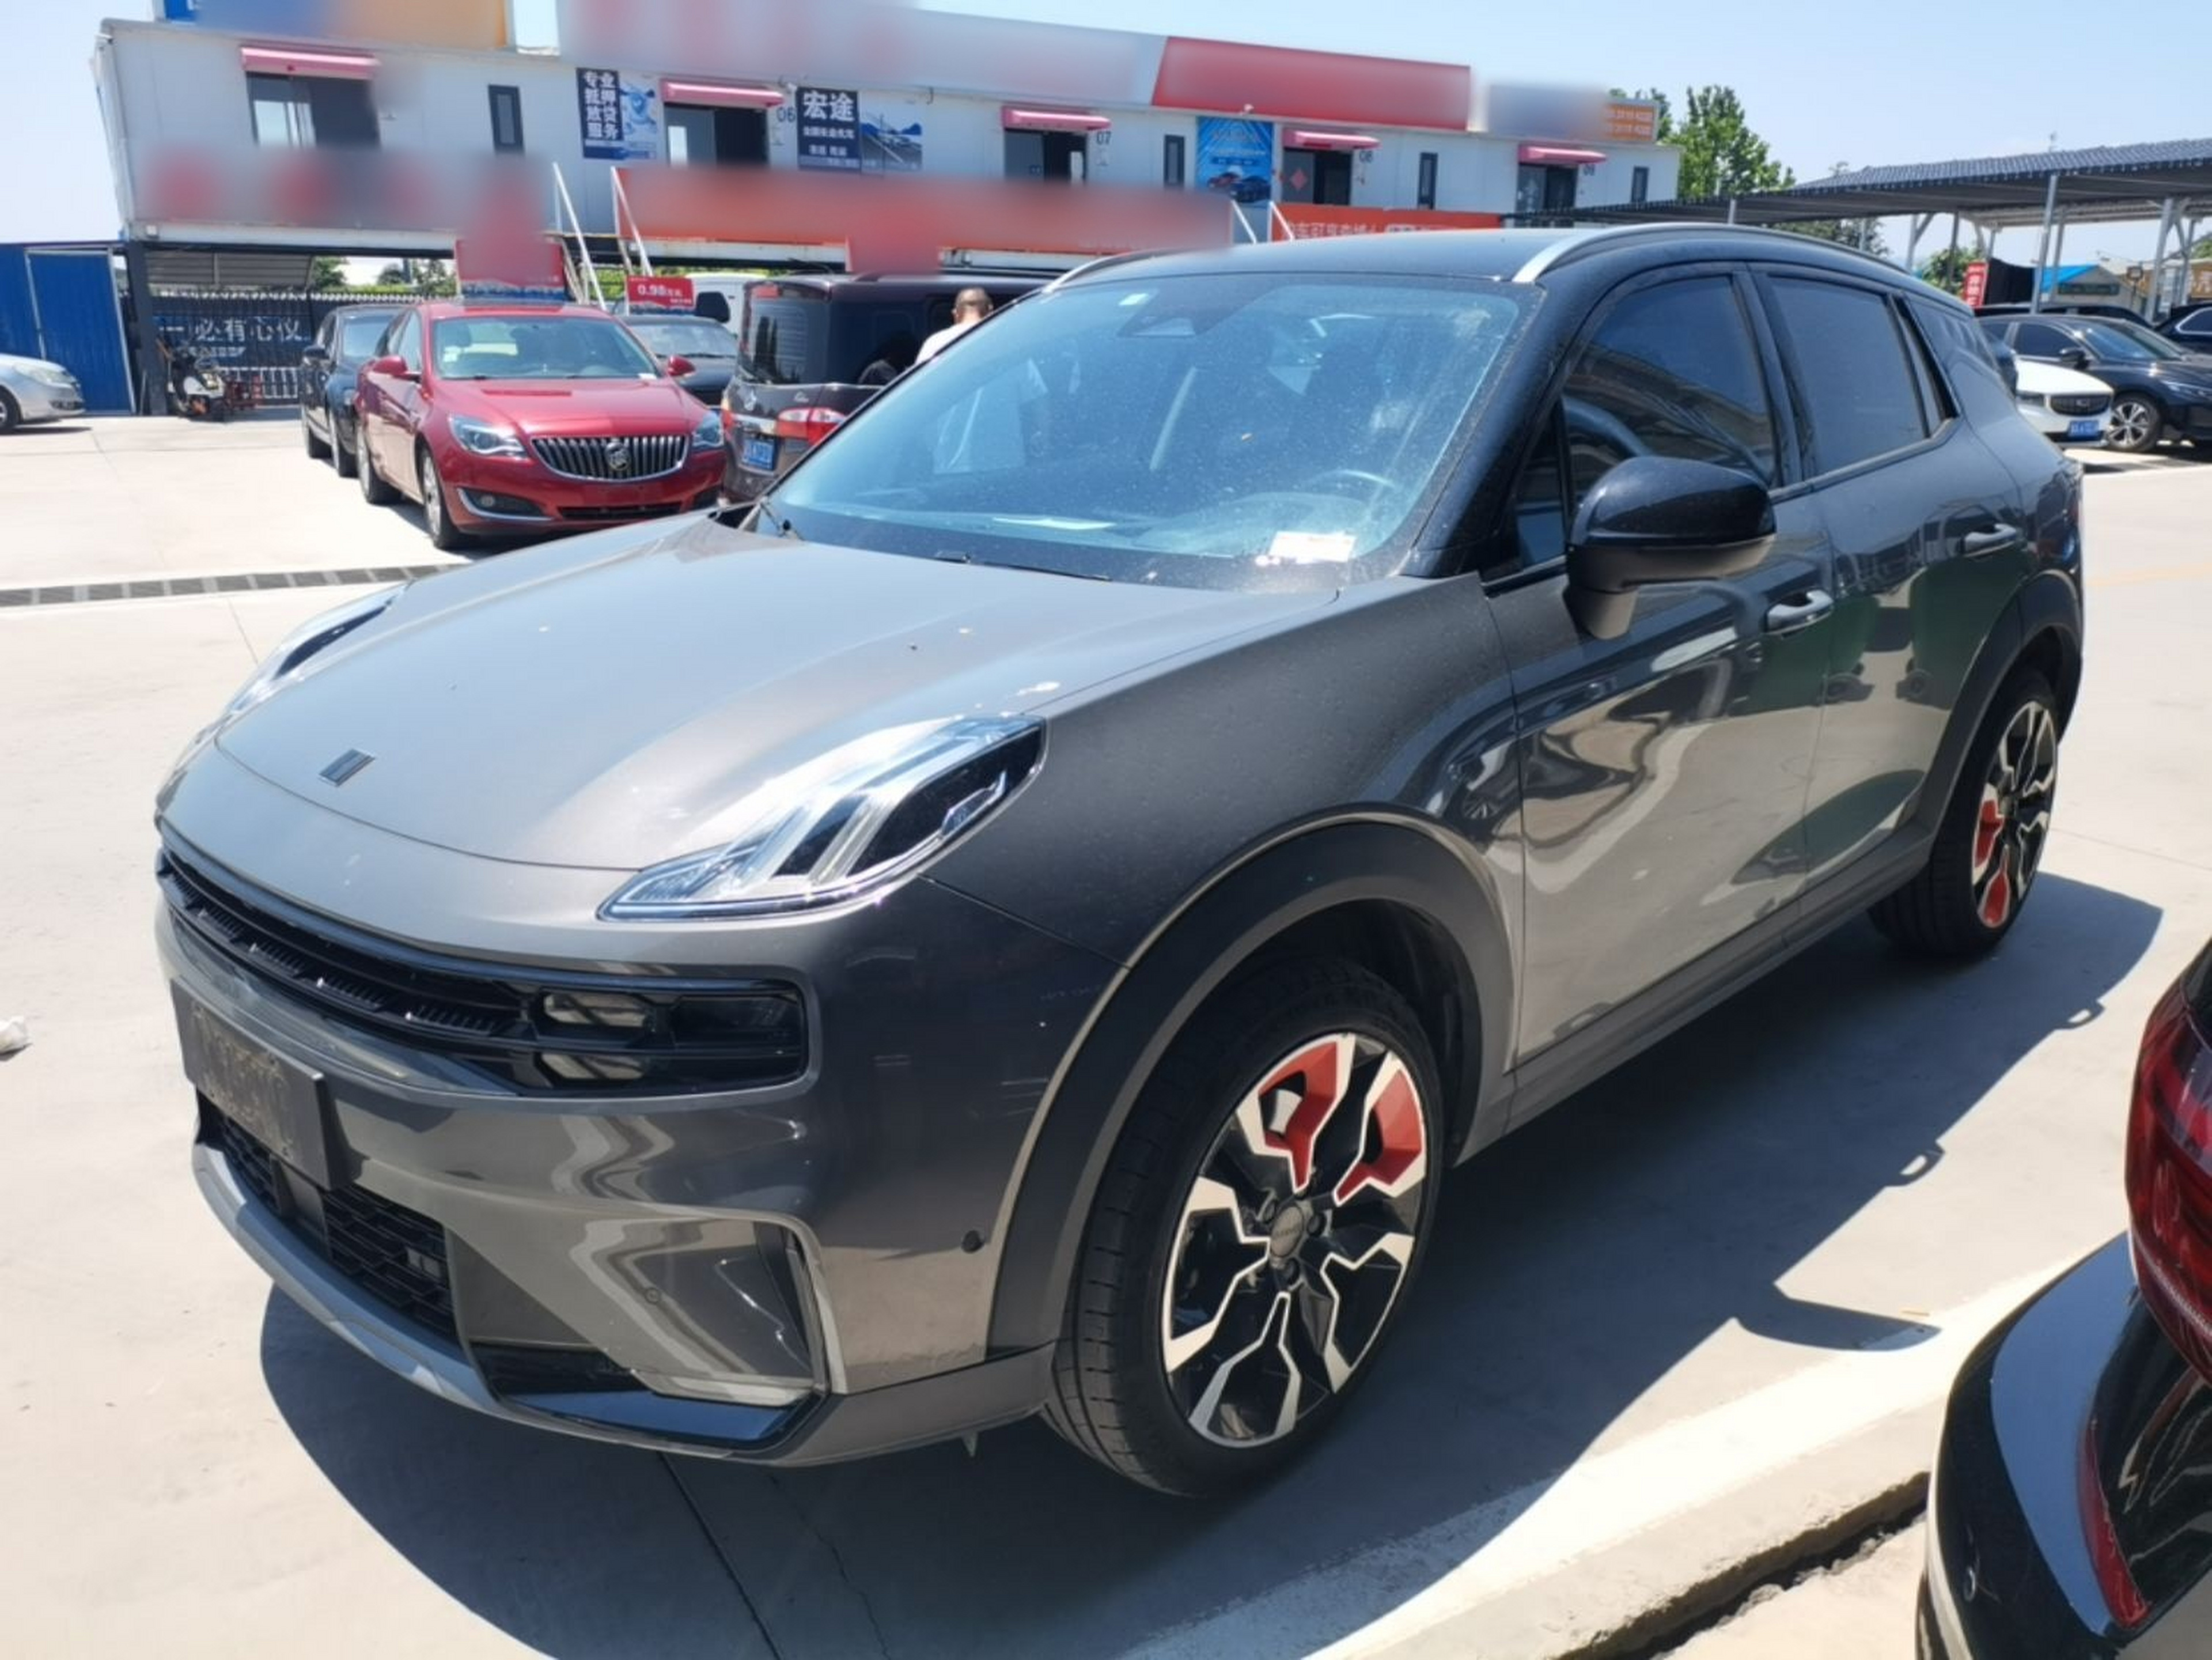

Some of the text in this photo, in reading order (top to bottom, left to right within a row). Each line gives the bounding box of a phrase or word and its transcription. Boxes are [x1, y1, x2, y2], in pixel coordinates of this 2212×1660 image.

[584, 71, 615, 88] 专业
[803, 90, 855, 122] 宏途
[777, 107, 796, 123] 06
[1096, 131, 1111, 146] 07
